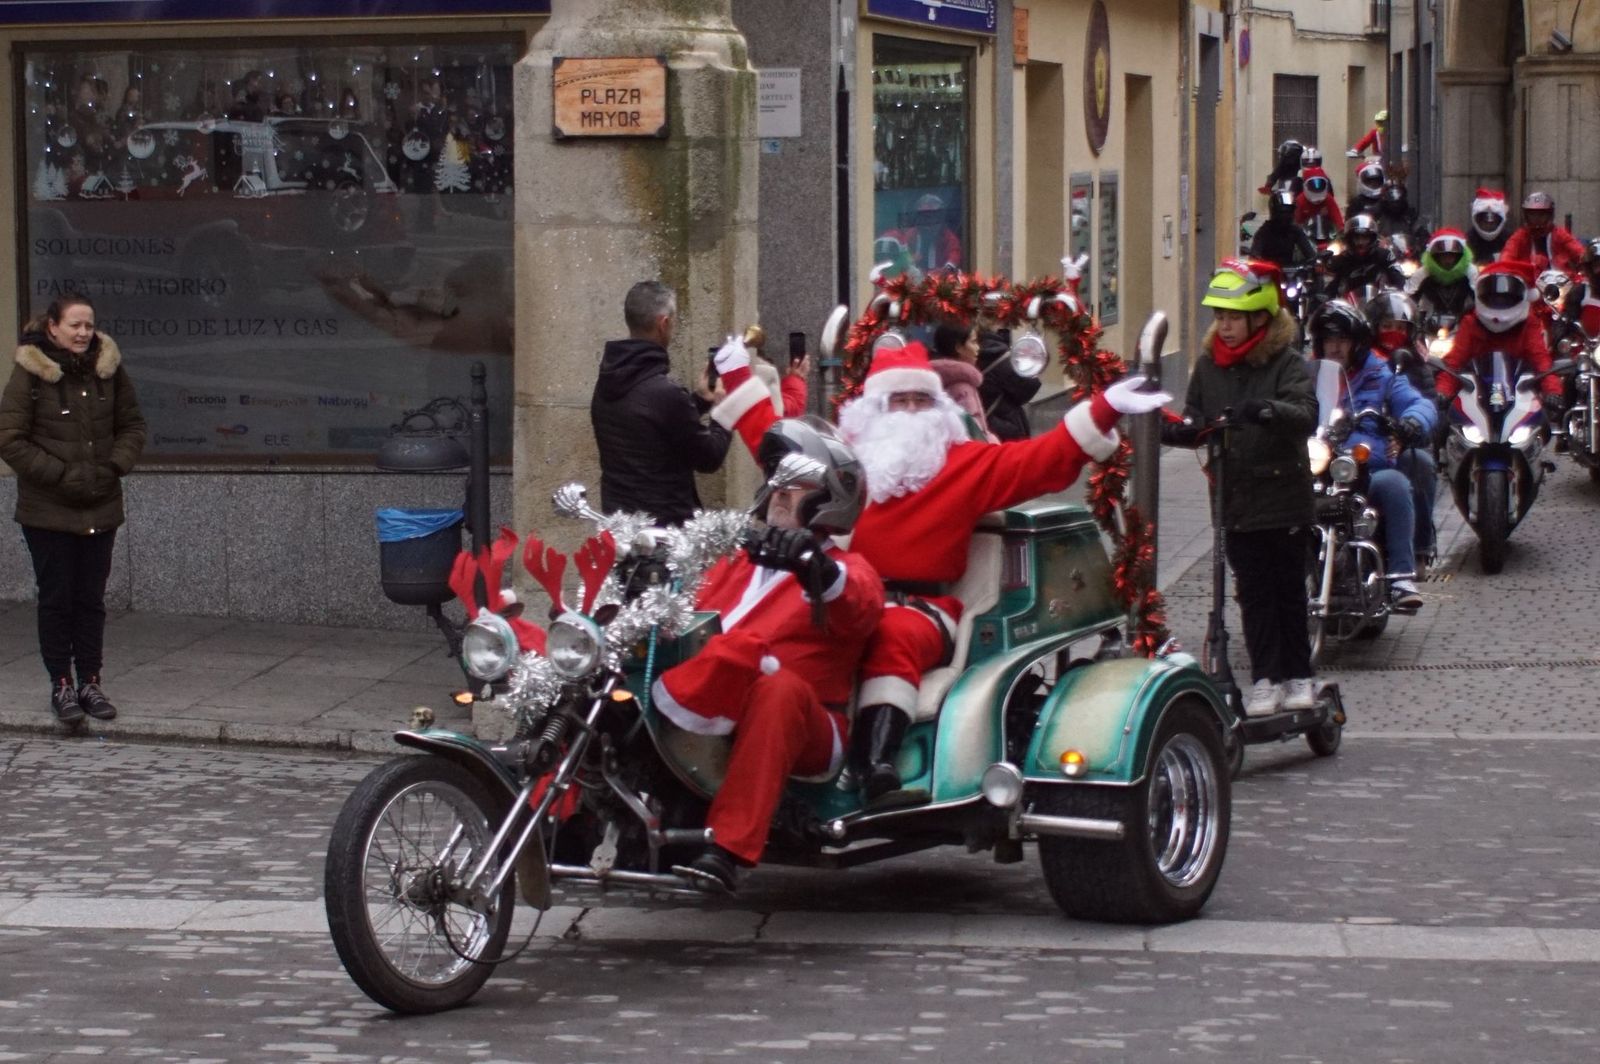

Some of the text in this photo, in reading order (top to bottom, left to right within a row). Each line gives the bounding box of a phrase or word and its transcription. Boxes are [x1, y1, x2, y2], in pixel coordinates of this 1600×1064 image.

[581, 88, 641, 104] PLAZA
[581, 111, 641, 127] MAYOR
[34, 238, 175, 255] SOLUCIONES
[37, 277, 227, 296] PARA TU AHORRO
[187, 319, 217, 336] DE
[224, 318, 266, 336] LUZ
[273, 319, 286, 336] Y
[293, 318, 339, 336] GAS
[187, 394, 226, 404] acciona
[318, 396, 368, 408] Naturgy
[264, 434, 290, 446] ELE
